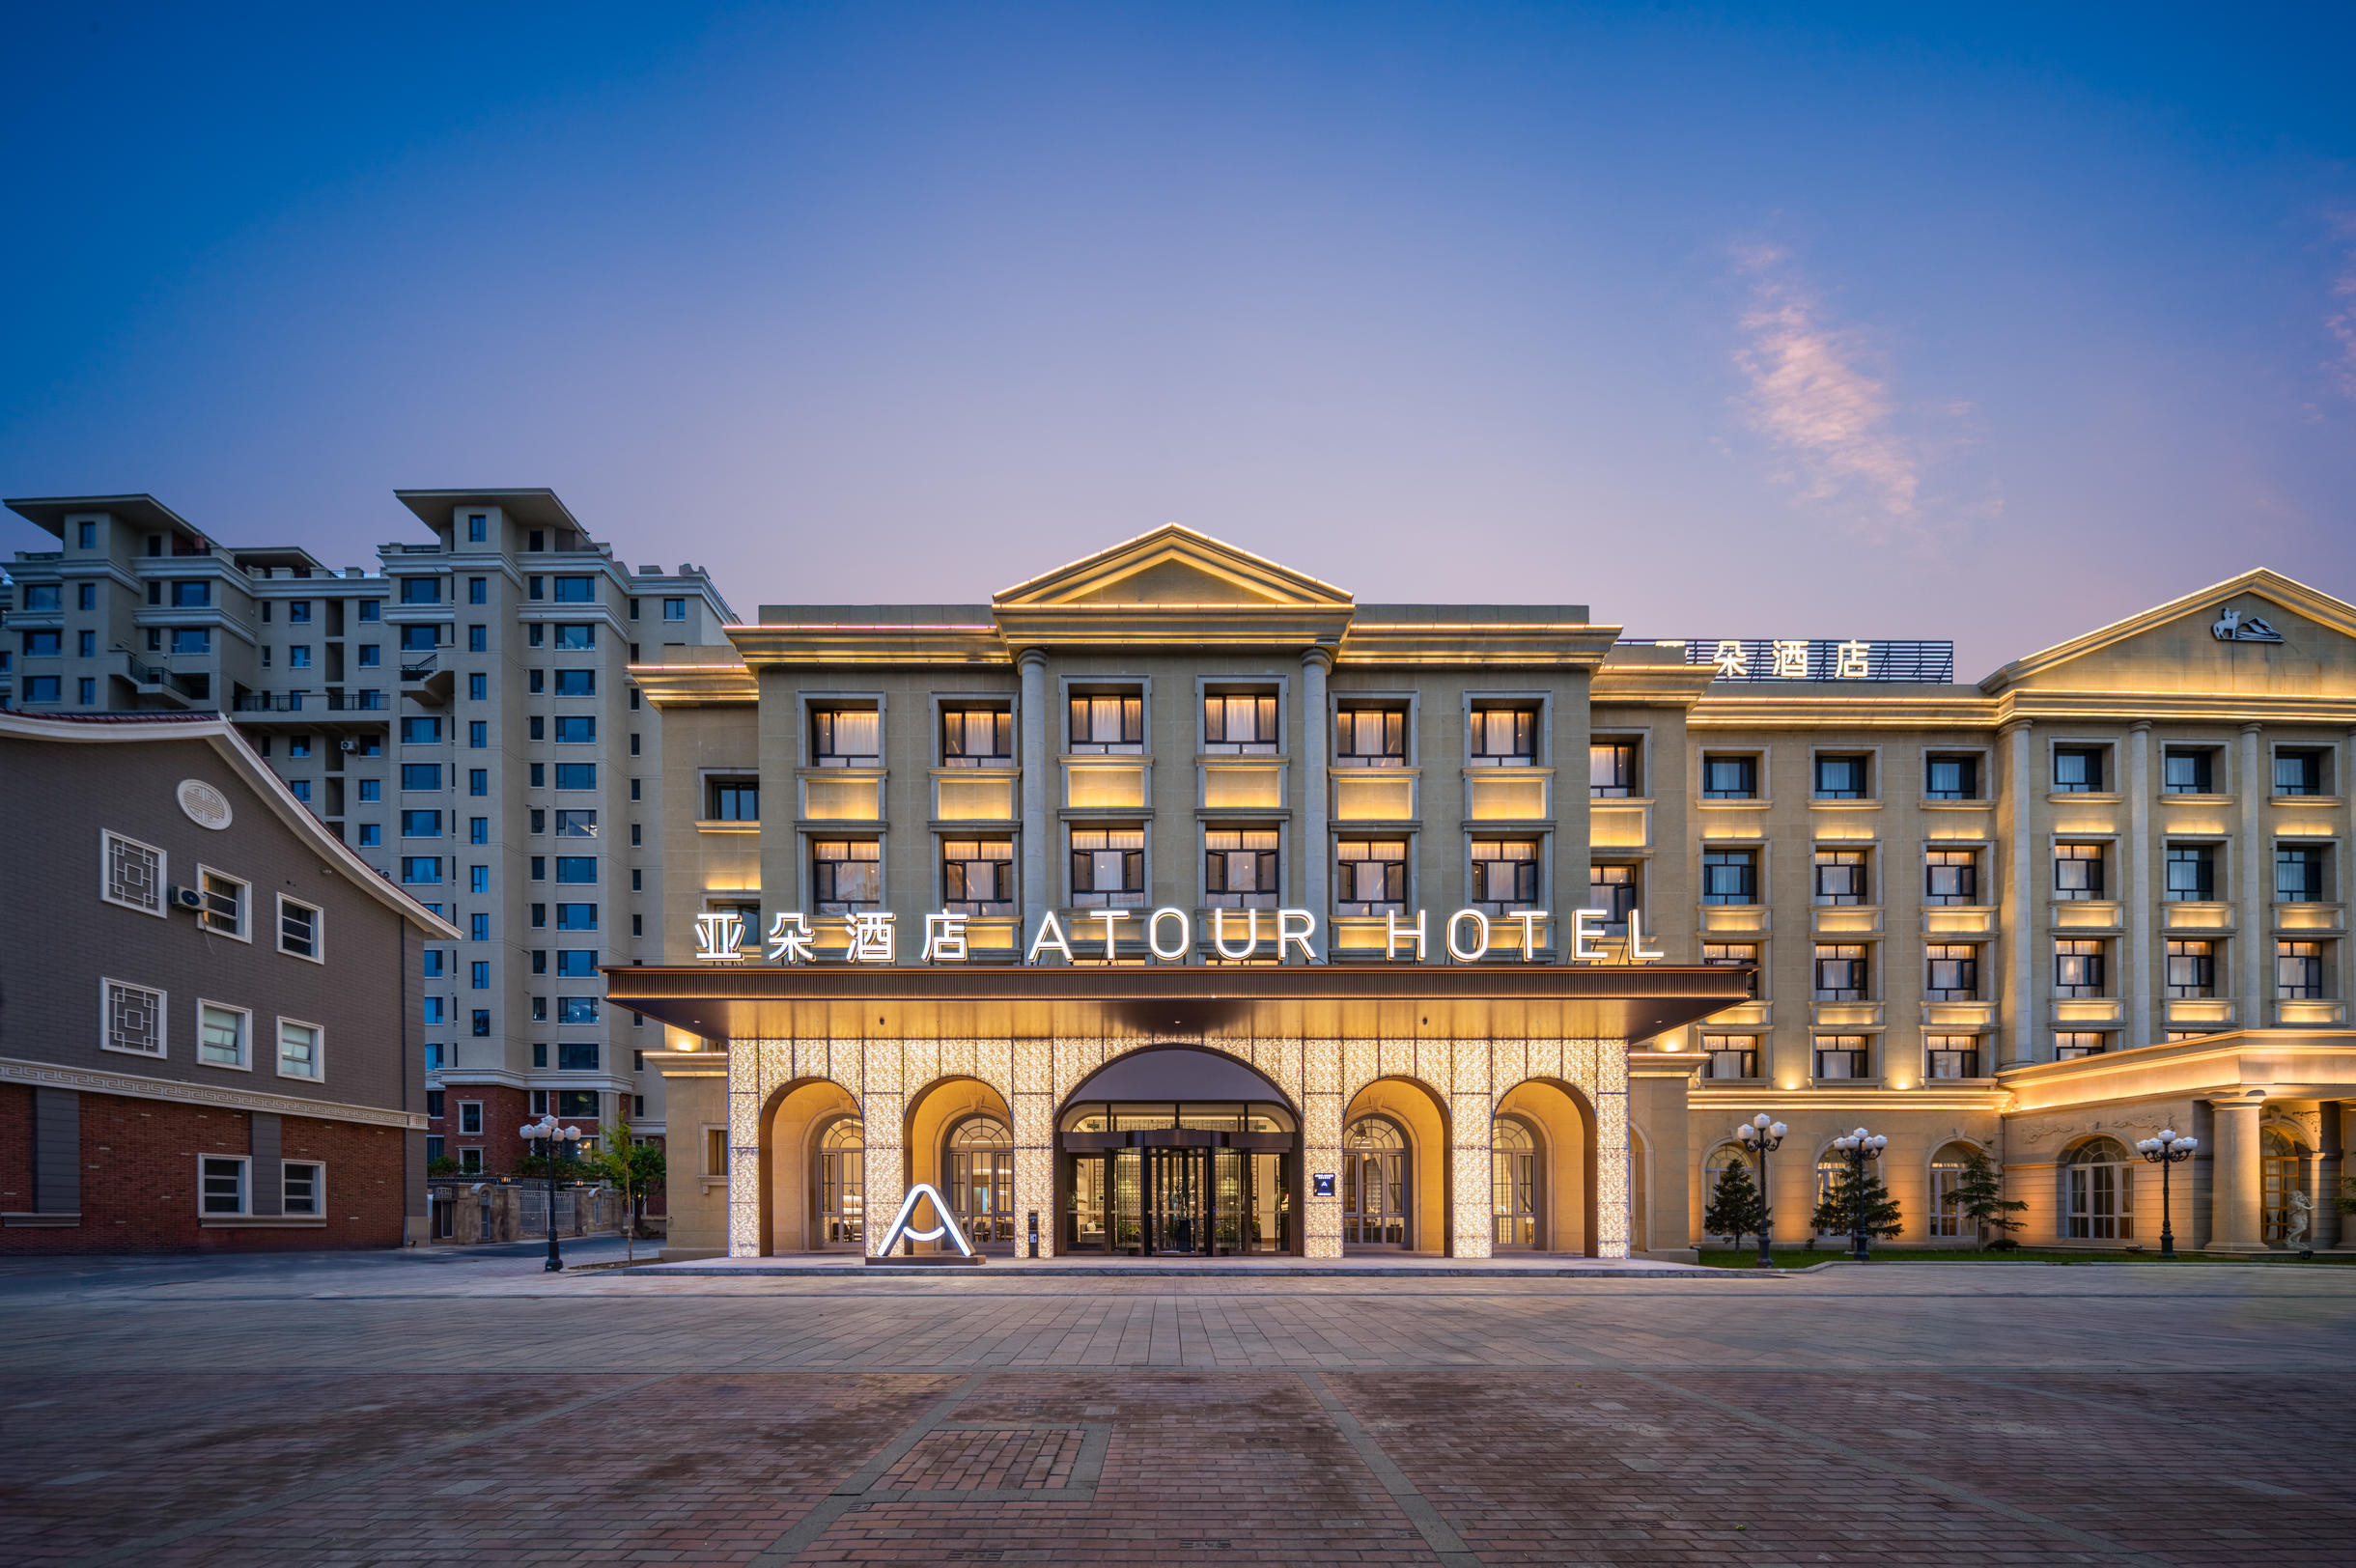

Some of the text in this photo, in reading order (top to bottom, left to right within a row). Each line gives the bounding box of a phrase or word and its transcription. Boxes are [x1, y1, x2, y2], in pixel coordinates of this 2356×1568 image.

[1655, 639, 1871, 679] 朵酒店
[694, 907, 1665, 962] 亚朵酒店 ATOUR HOTEL
